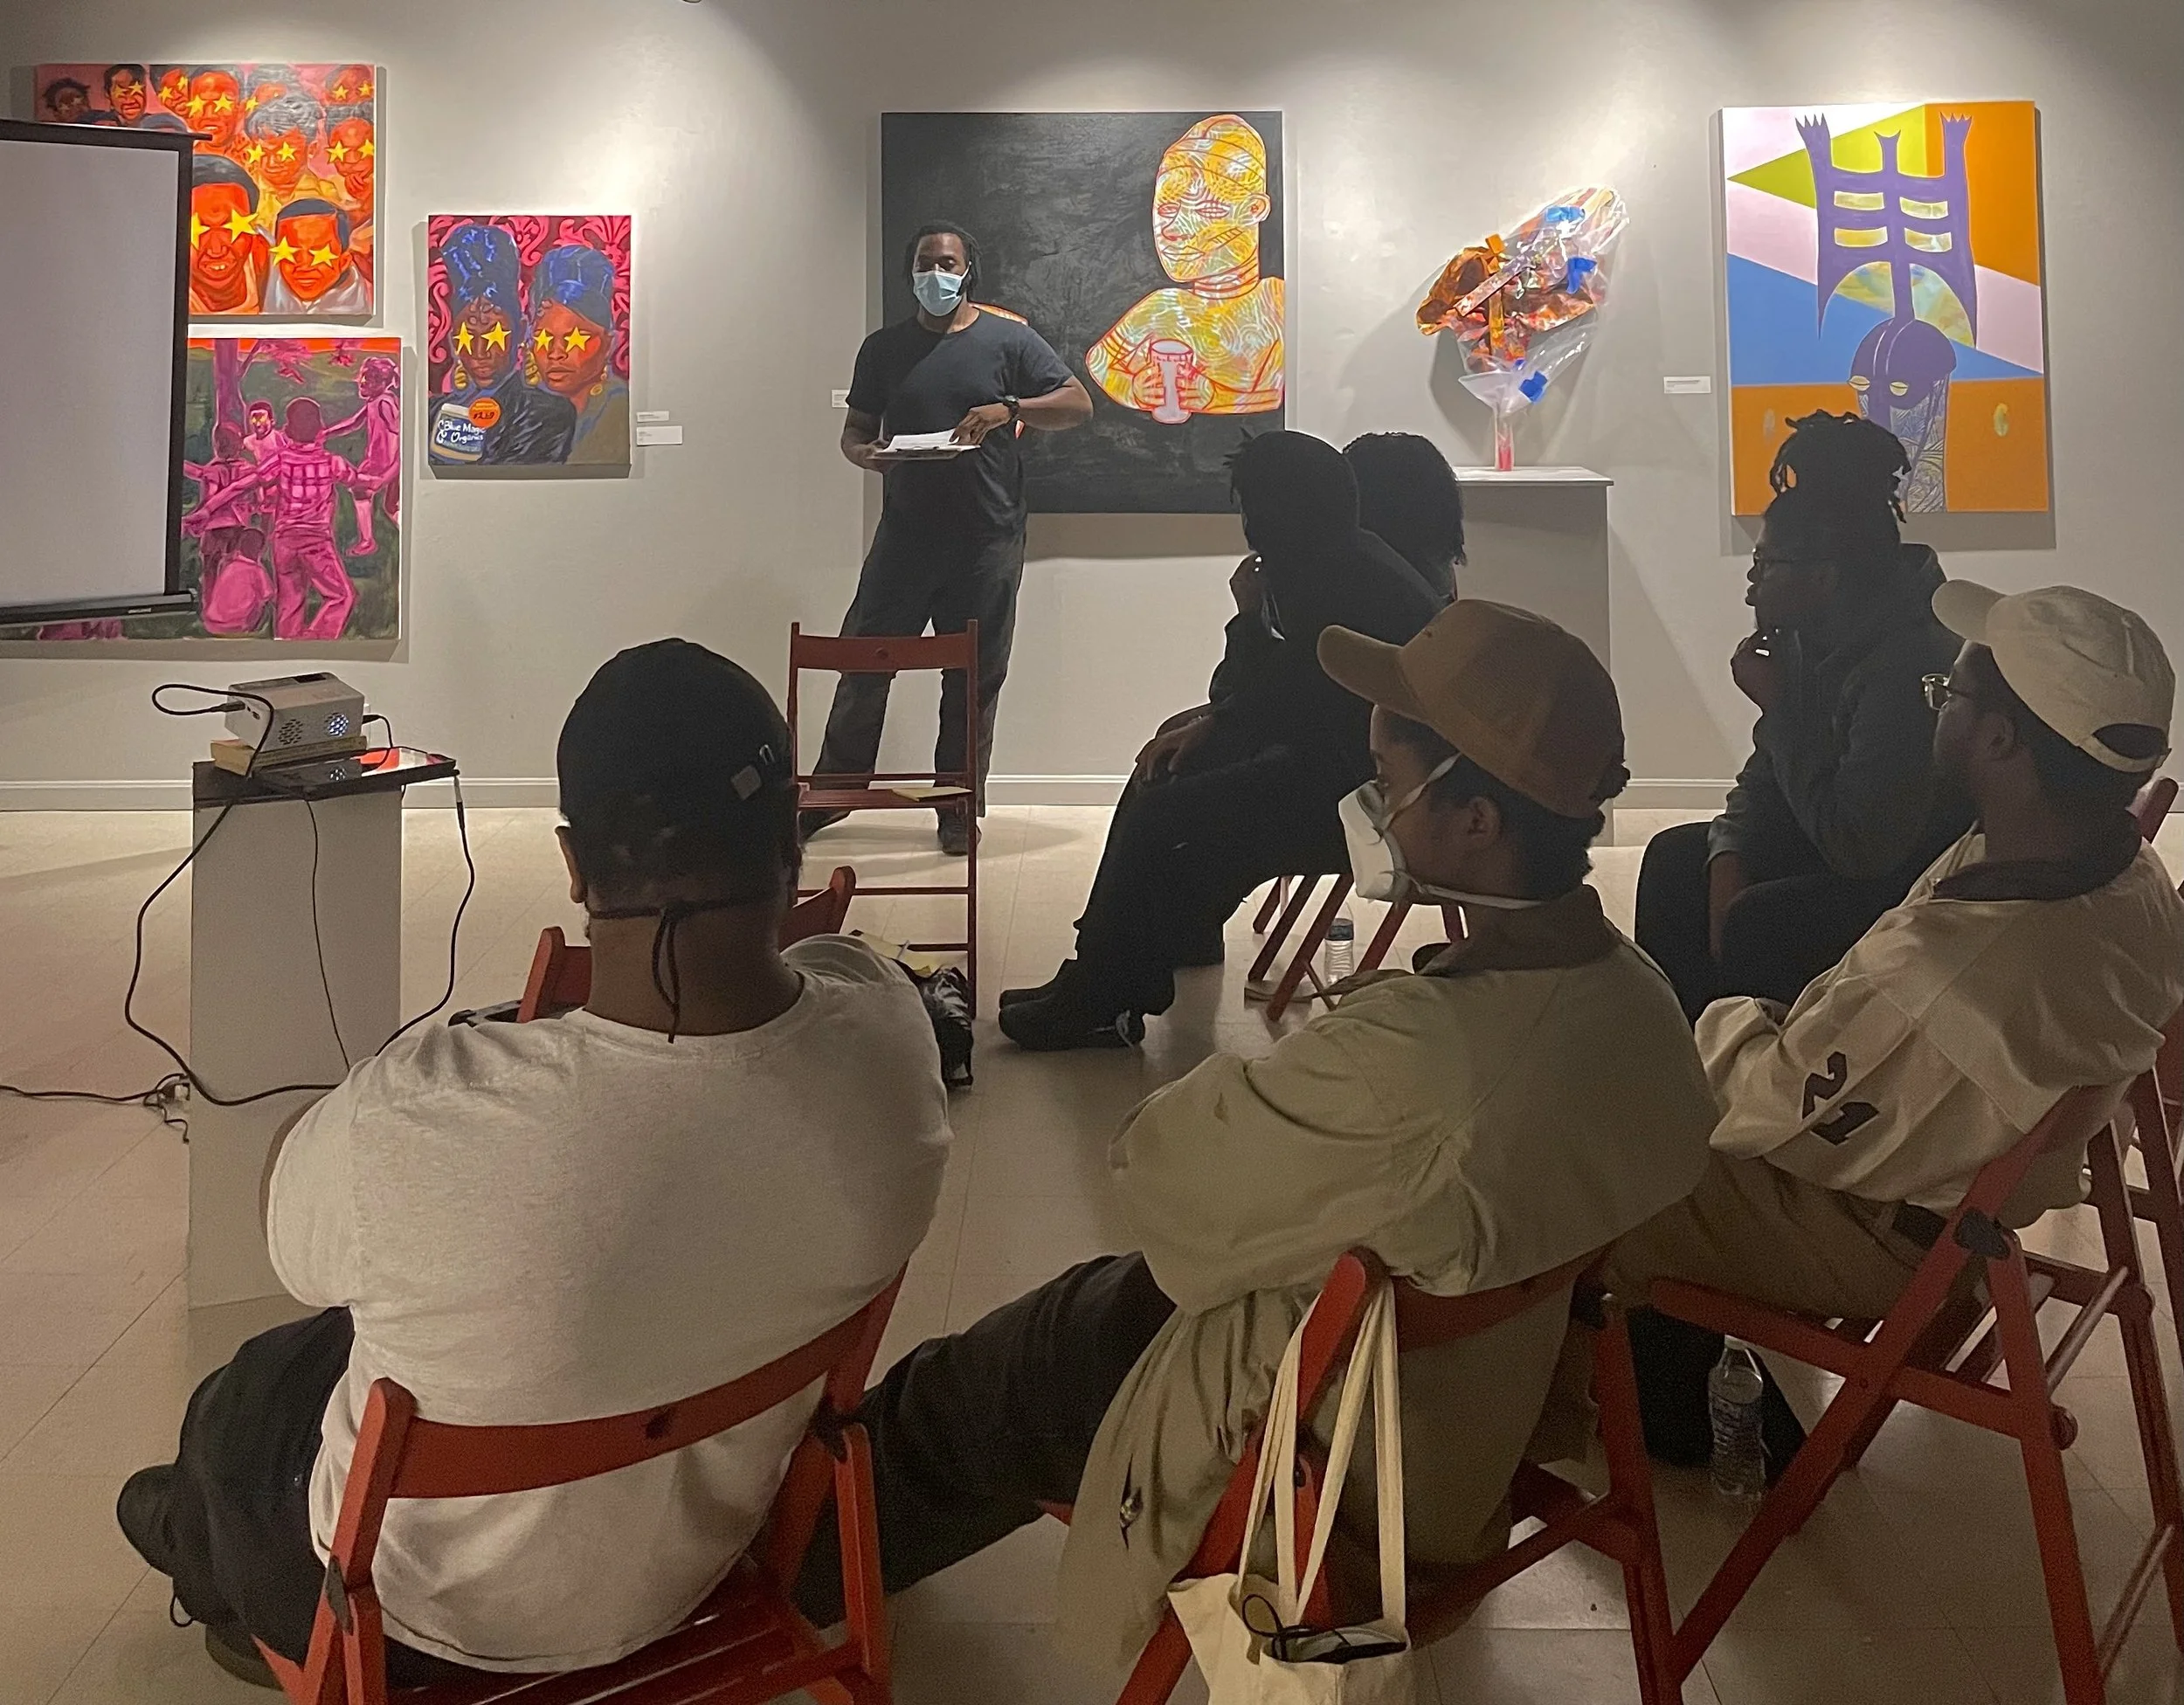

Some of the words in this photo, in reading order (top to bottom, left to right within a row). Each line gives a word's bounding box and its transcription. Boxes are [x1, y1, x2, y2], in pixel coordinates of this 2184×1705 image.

[444, 421, 461, 431] Blue
[462, 423, 487, 435] Magic
[1802, 1051, 1879, 1146] 21
